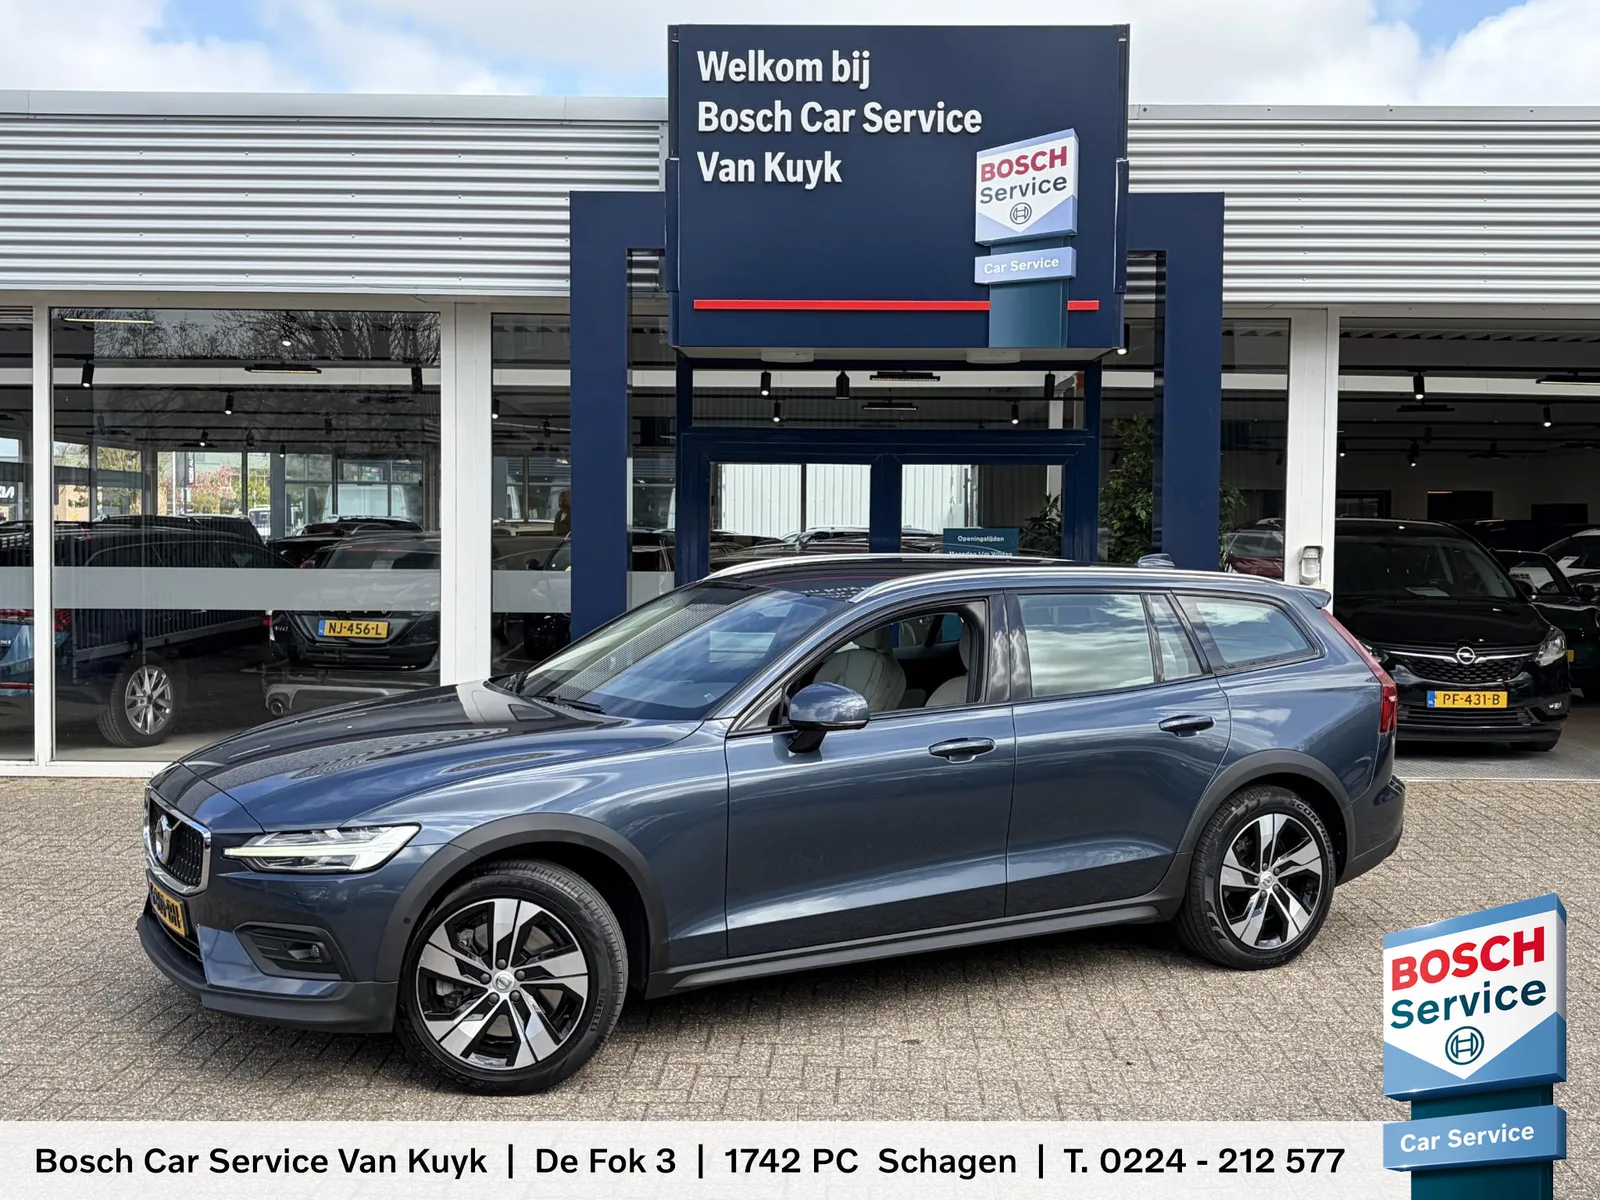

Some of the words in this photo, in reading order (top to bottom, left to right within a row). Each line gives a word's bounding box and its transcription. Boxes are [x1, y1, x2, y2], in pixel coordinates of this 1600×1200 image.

[696, 49, 823, 82] Welkom
[831, 49, 871, 90] bij
[697, 99, 792, 133] Bosch
[800, 101, 857, 133] Car
[862, 101, 983, 134] Service
[696, 151, 755, 183] Van
[764, 150, 843, 190] Kuyk
[981, 146, 1067, 182] BOSCH
[980, 176, 1067, 204] Service
[984, 263, 1006, 274] Car
[1010, 257, 1060, 272] Service
[957, 535, 1005, 543] Openingstijden
[328, 622, 382, 636] NJ-456-L
[1443, 693, 1500, 706] PF-431-B
